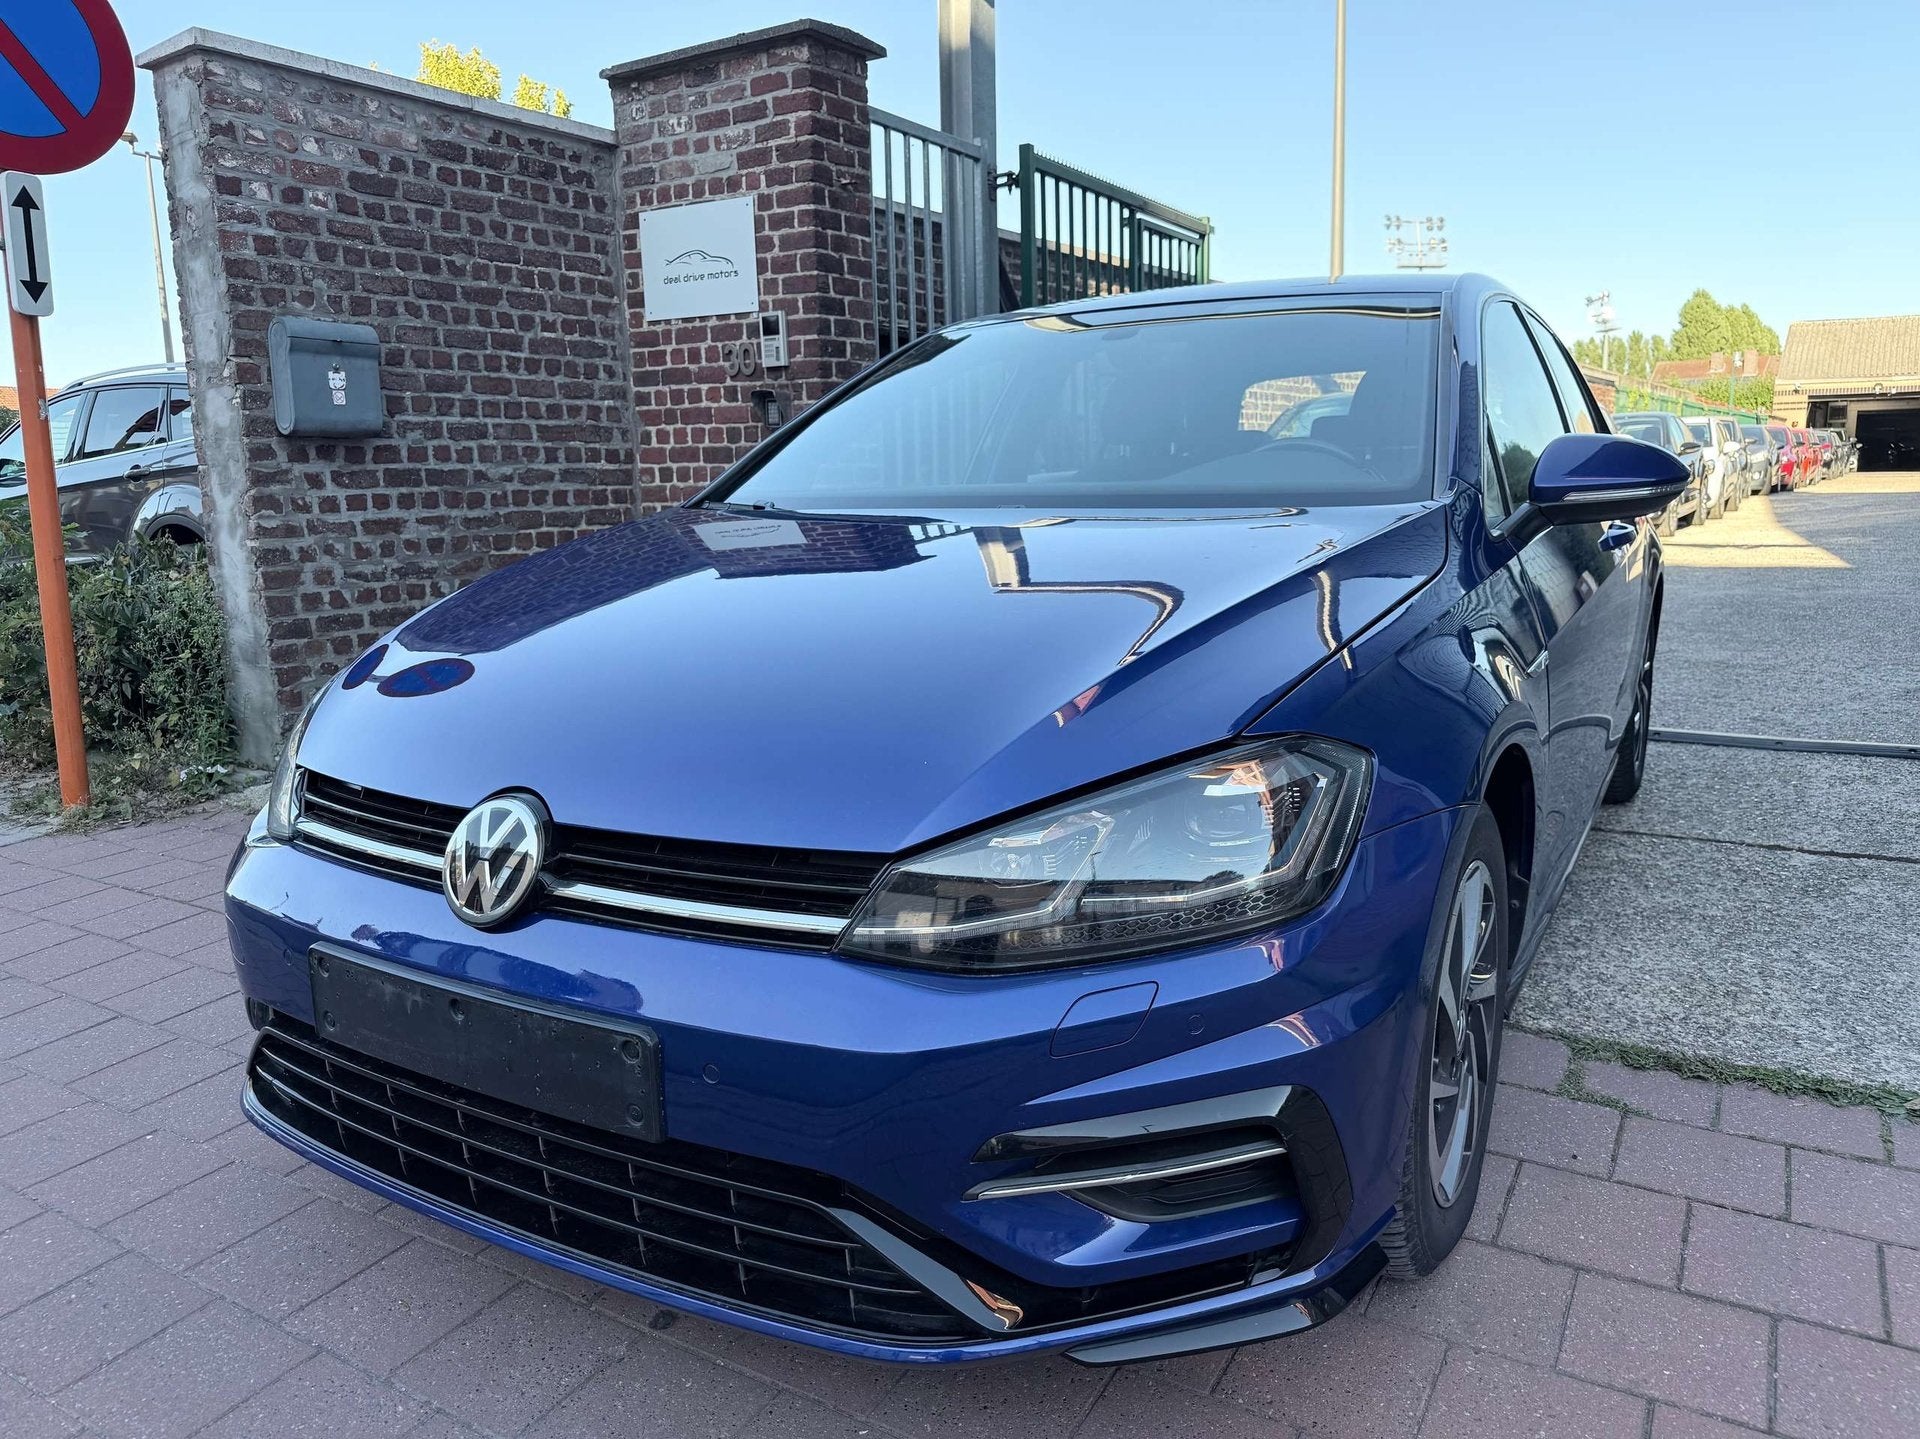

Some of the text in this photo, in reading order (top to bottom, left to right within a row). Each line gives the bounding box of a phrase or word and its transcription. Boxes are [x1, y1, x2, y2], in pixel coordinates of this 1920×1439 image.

[663, 270, 739, 285] deal drive motors
[724, 343, 756, 376] 30
